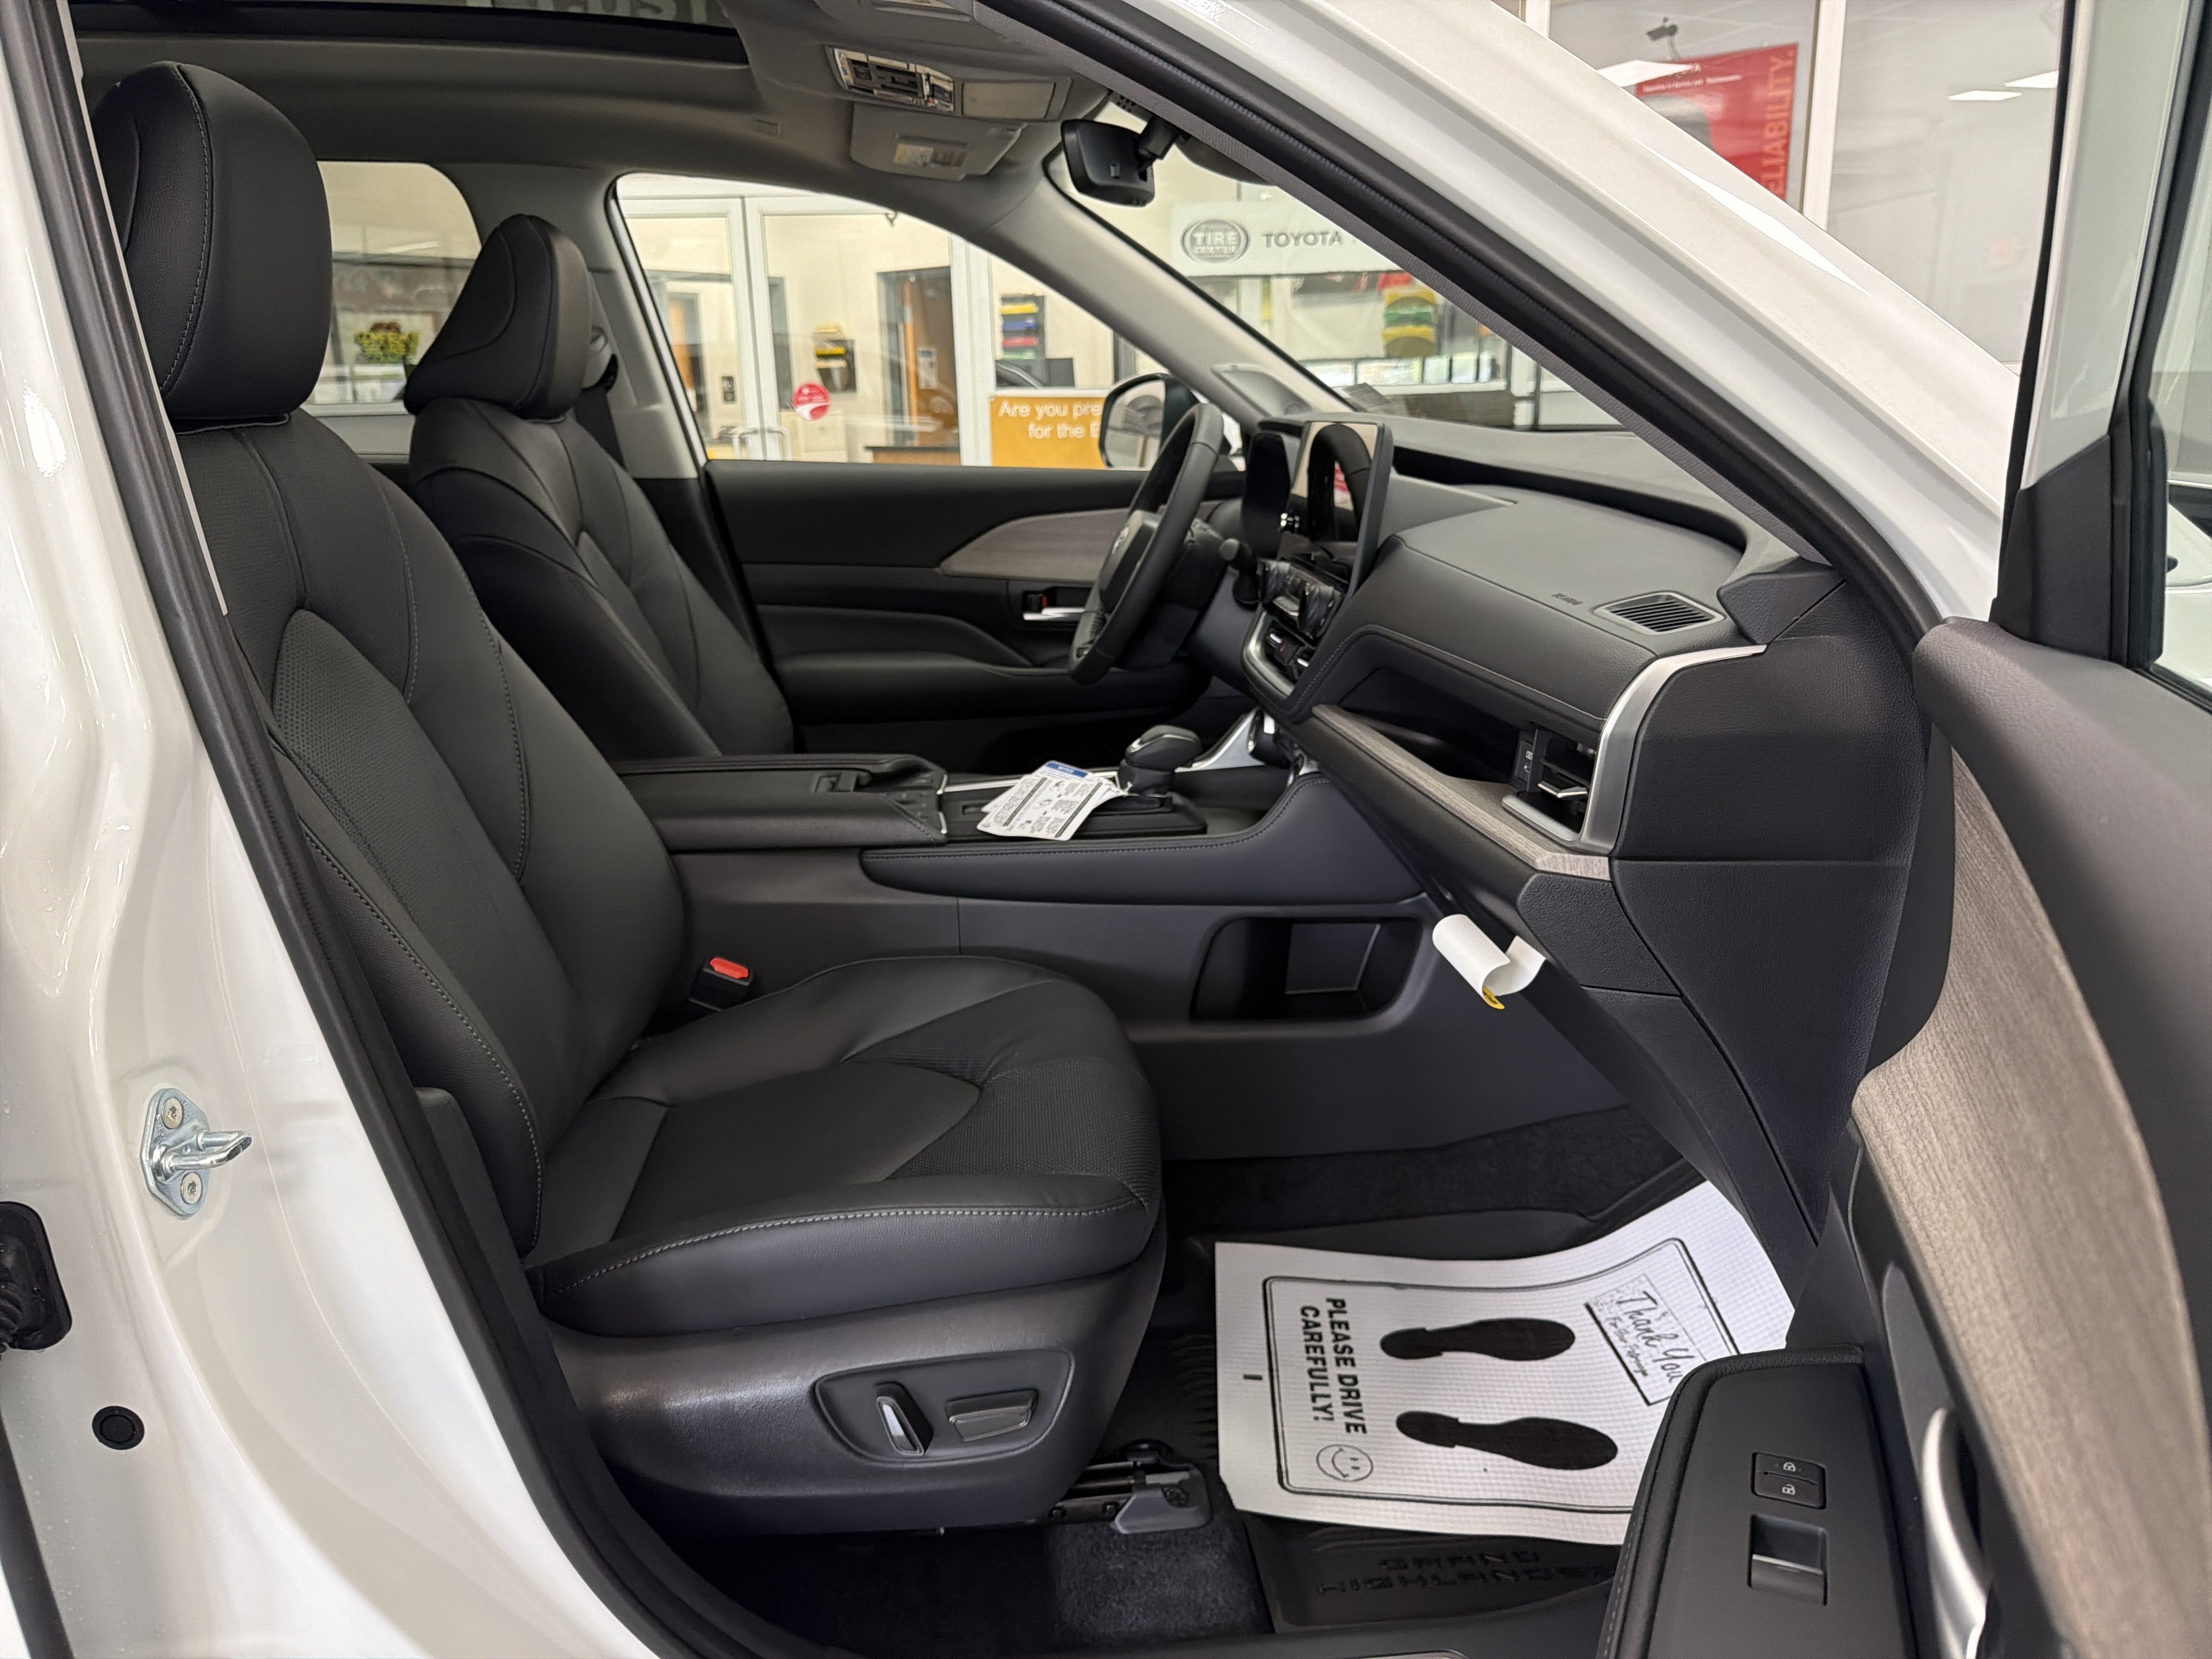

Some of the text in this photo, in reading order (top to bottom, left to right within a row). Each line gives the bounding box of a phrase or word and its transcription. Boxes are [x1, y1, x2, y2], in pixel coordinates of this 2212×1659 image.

[1192, 232, 1238, 245] TIRE
[1262, 230, 1344, 248] TOYOTA
[998, 399, 1031, 417] Are
[1035, 402, 1068, 420] you
[1028, 421, 1053, 439] for
[1057, 421, 1086, 439] the
[1616, 1290, 1679, 1348] Thank
[1651, 1348, 1695, 1383] You
[1300, 1305, 1334, 1421] CAREFULLY!
[1326, 1297, 1368, 1434] PLEASE DRIVE
[1378, 1550, 1537, 1570] GRAND
